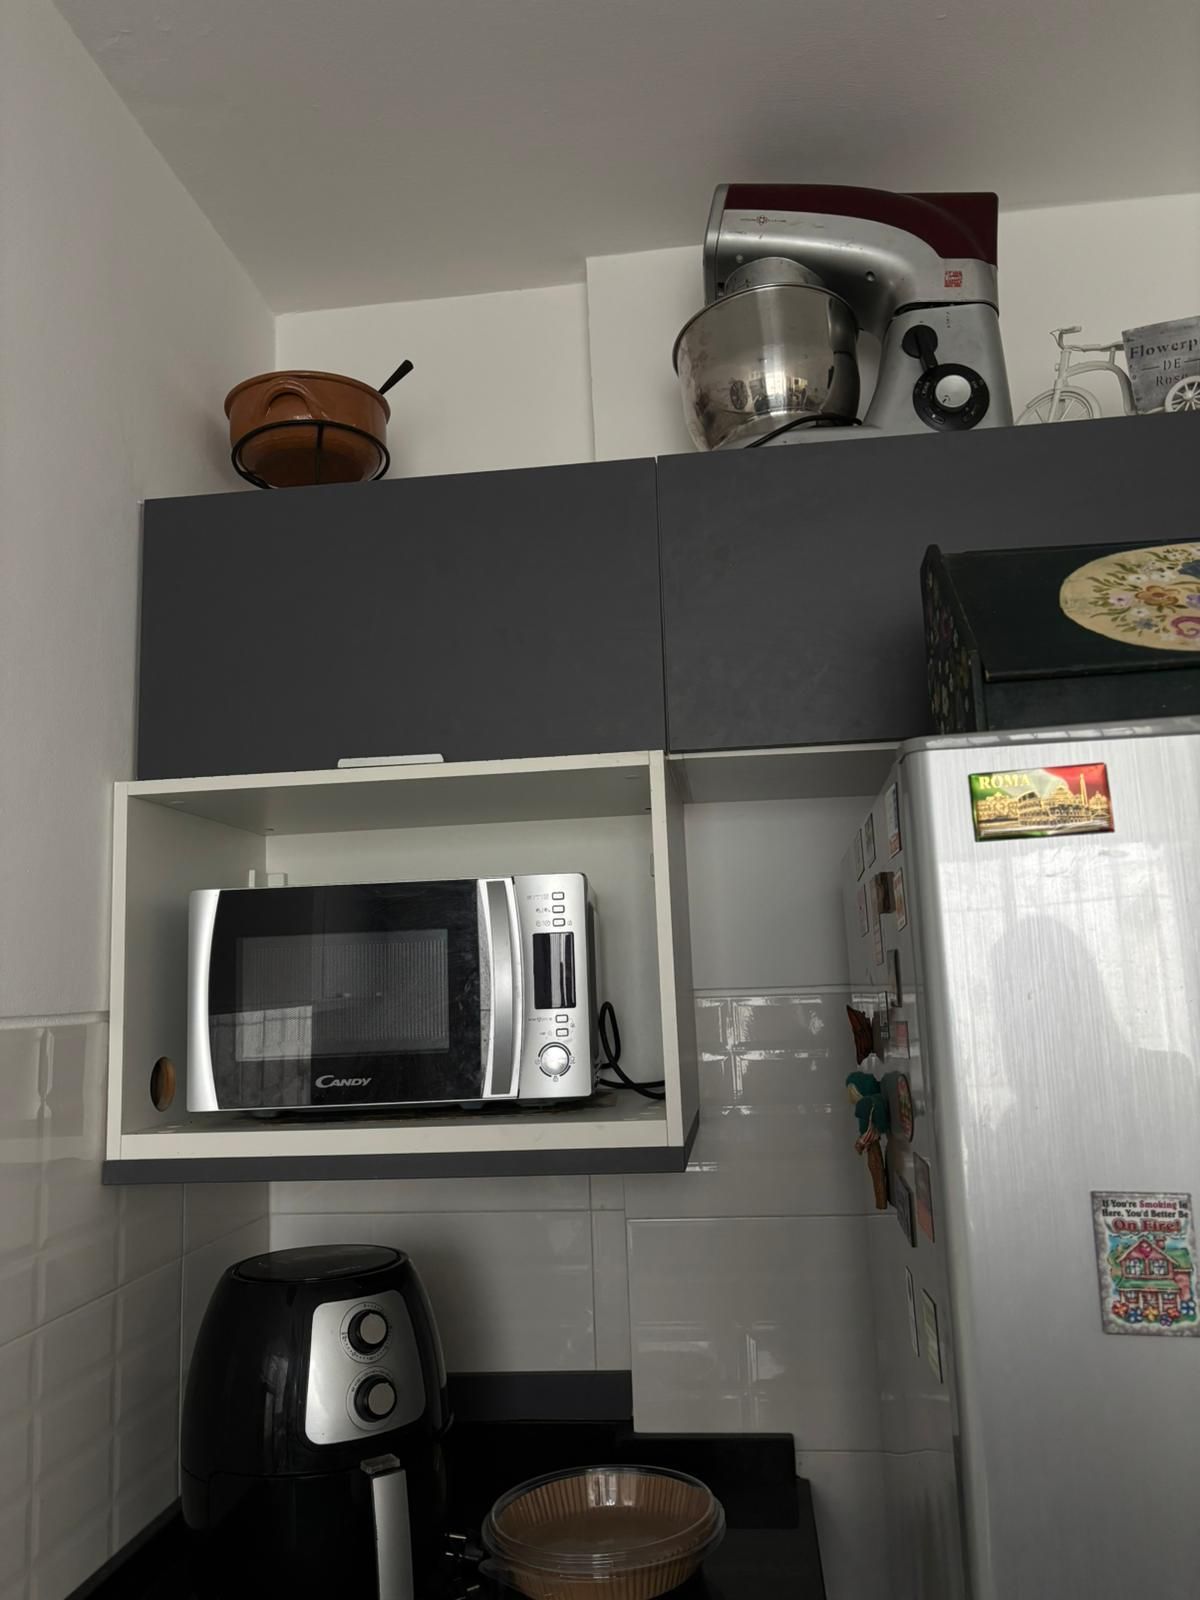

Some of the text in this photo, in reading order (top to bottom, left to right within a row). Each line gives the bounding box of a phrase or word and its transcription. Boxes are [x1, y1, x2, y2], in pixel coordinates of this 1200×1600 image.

[1163, 358, 1181, 370] DE
[978, 774, 1031, 790] ROMA
[1111, 1199, 1137, 1208] You're
[1139, 1200, 1178, 1210] Smoking
[1125, 1209, 1149, 1217] You'd
[1151, 1210, 1176, 1218] Better
[1178, 1210, 1189, 1218] Be
[1112, 1218, 1138, 1232] On
